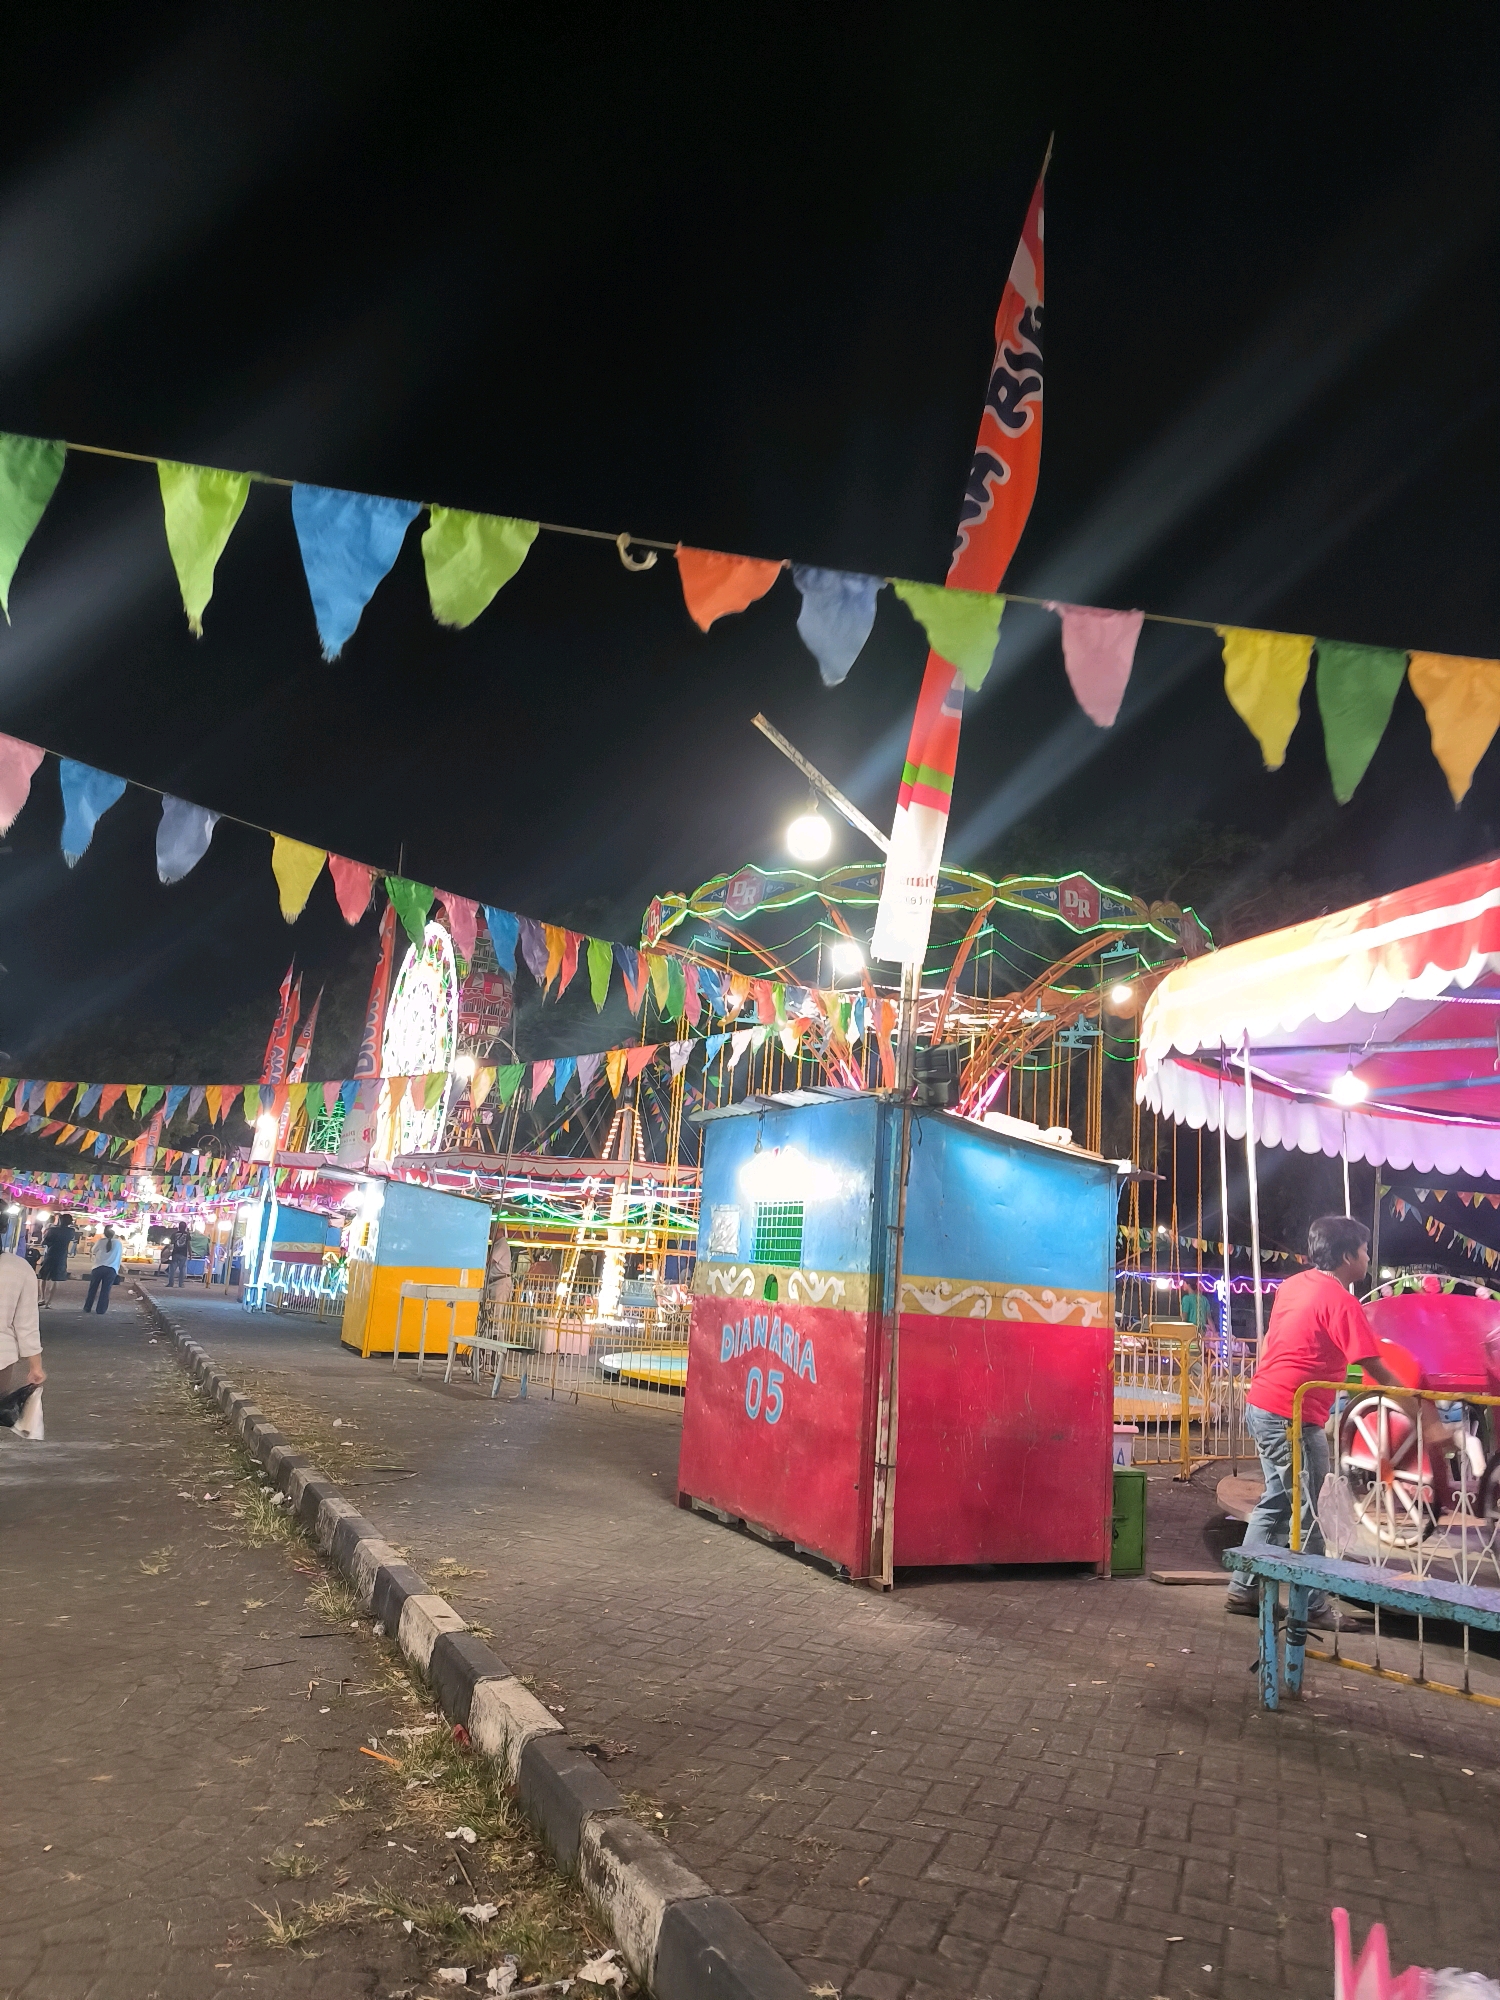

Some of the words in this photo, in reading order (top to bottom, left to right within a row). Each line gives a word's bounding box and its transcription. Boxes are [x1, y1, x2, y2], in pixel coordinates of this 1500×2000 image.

[732, 880, 757, 906] DR
[1065, 889, 1091, 919] DR
[650, 909, 660, 934] DR
[745, 1366, 784, 1425] 05
